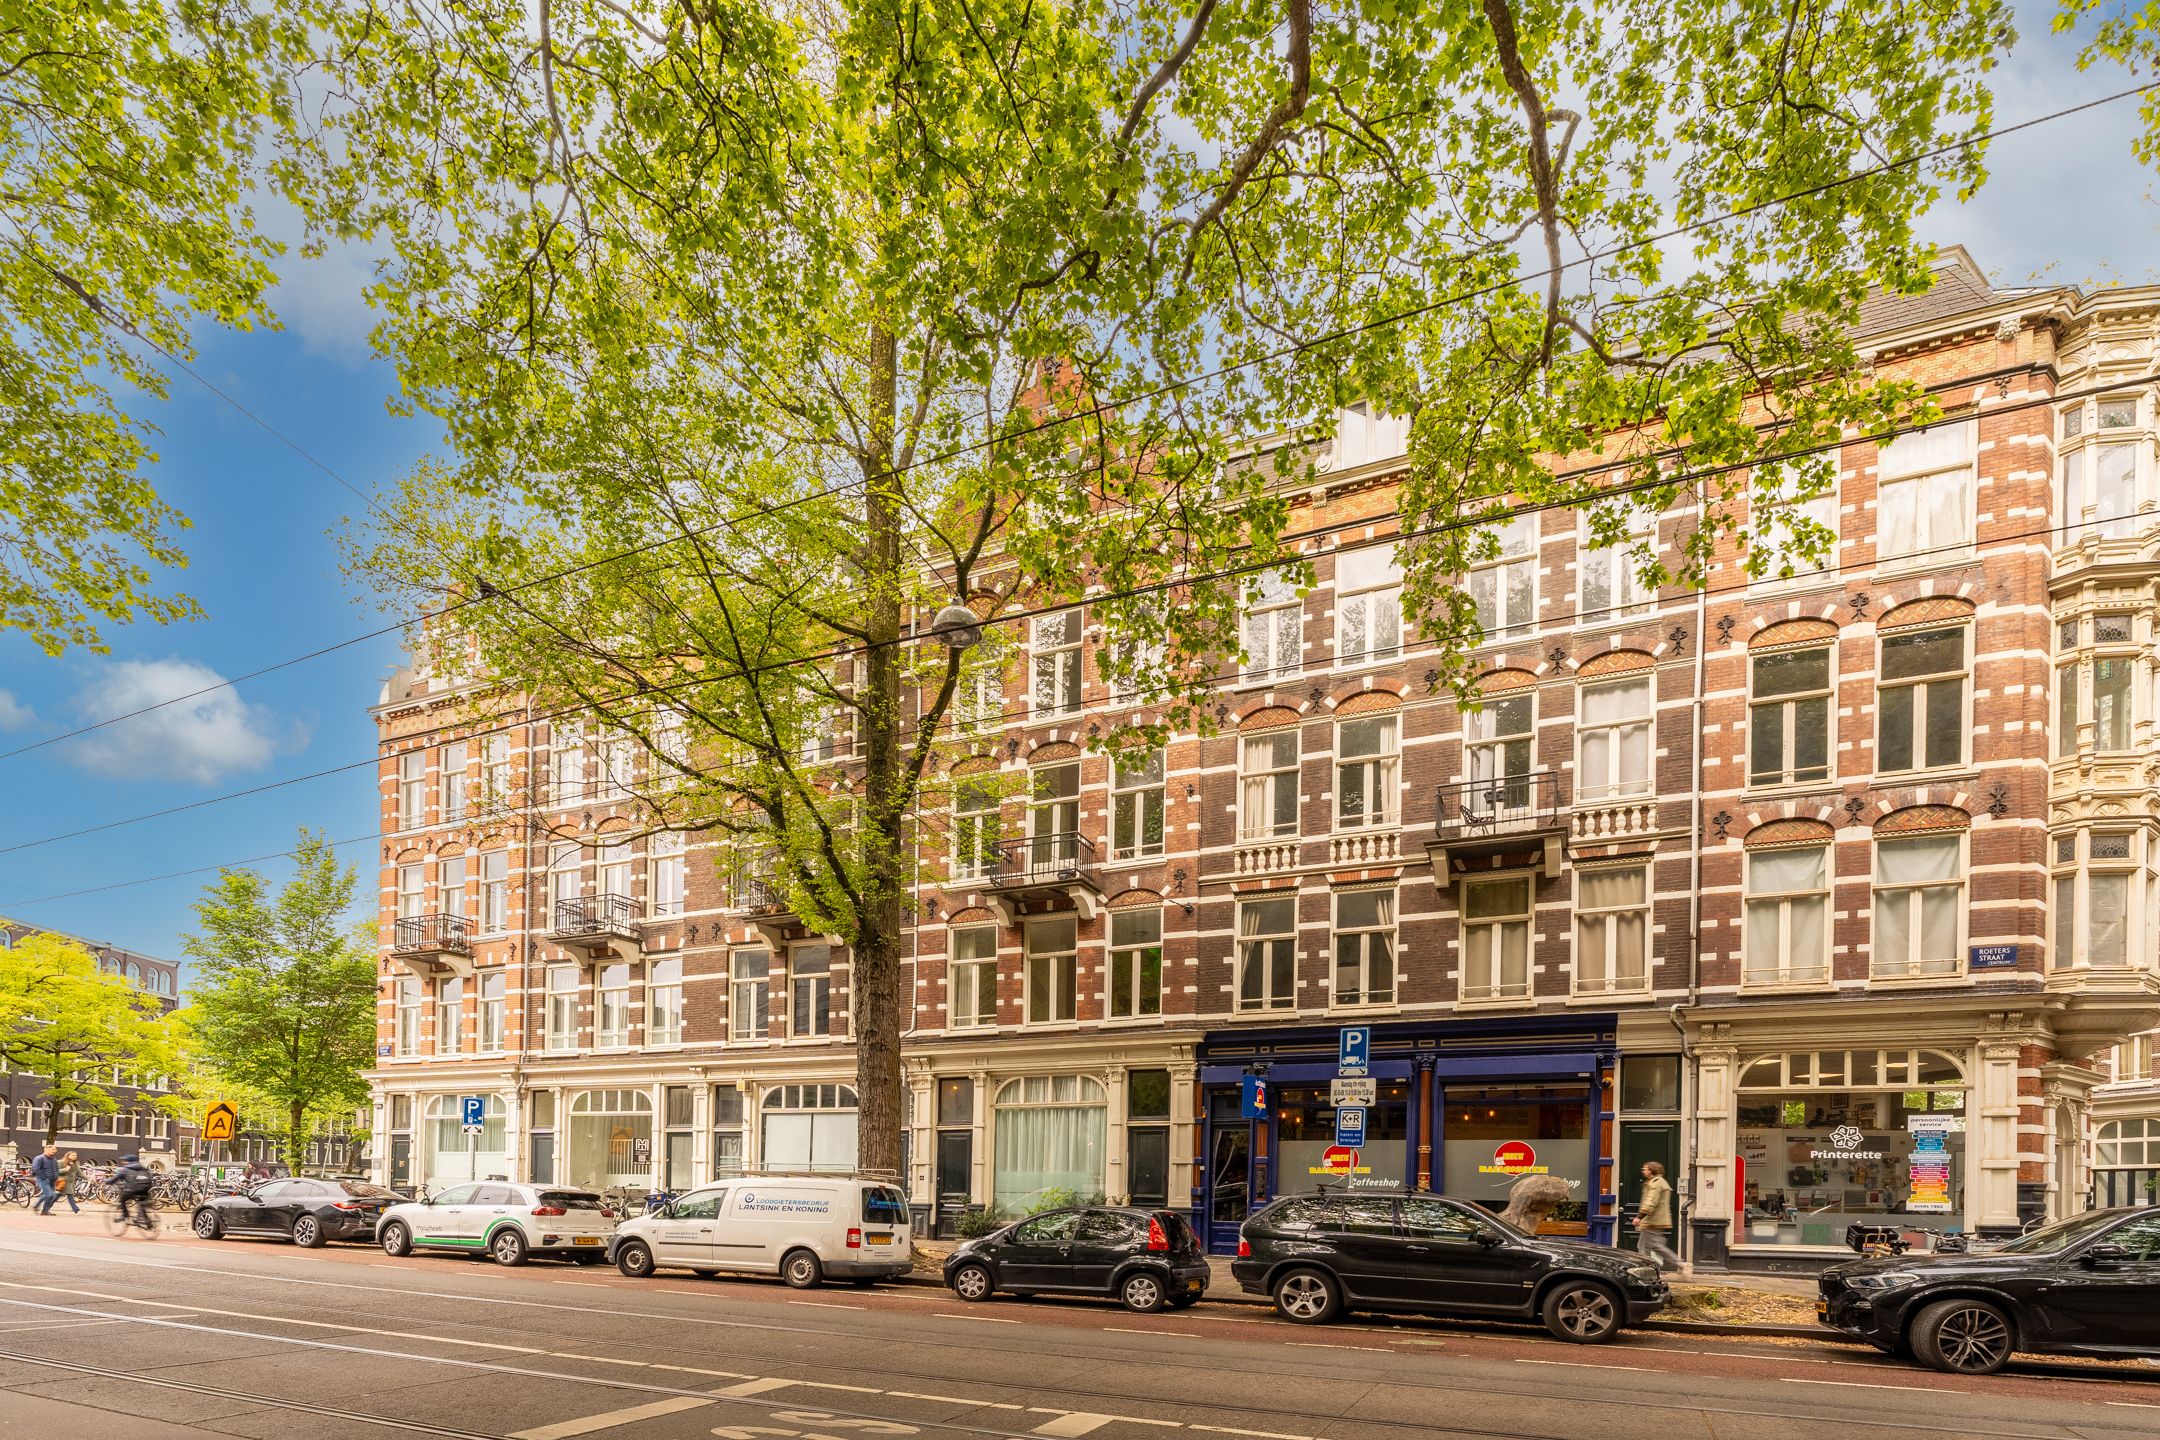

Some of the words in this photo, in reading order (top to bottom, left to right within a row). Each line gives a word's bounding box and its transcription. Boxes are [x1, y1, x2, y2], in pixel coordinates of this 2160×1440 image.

[1346, 1031, 1362, 1052] P
[468, 1100, 480, 1114] P
[1342, 1114, 1360, 1122] K+R
[212, 1118, 226, 1130] A
[1810, 1150, 1882, 1159] Printerette
[1352, 1178, 1400, 1188] Coffeeshop
